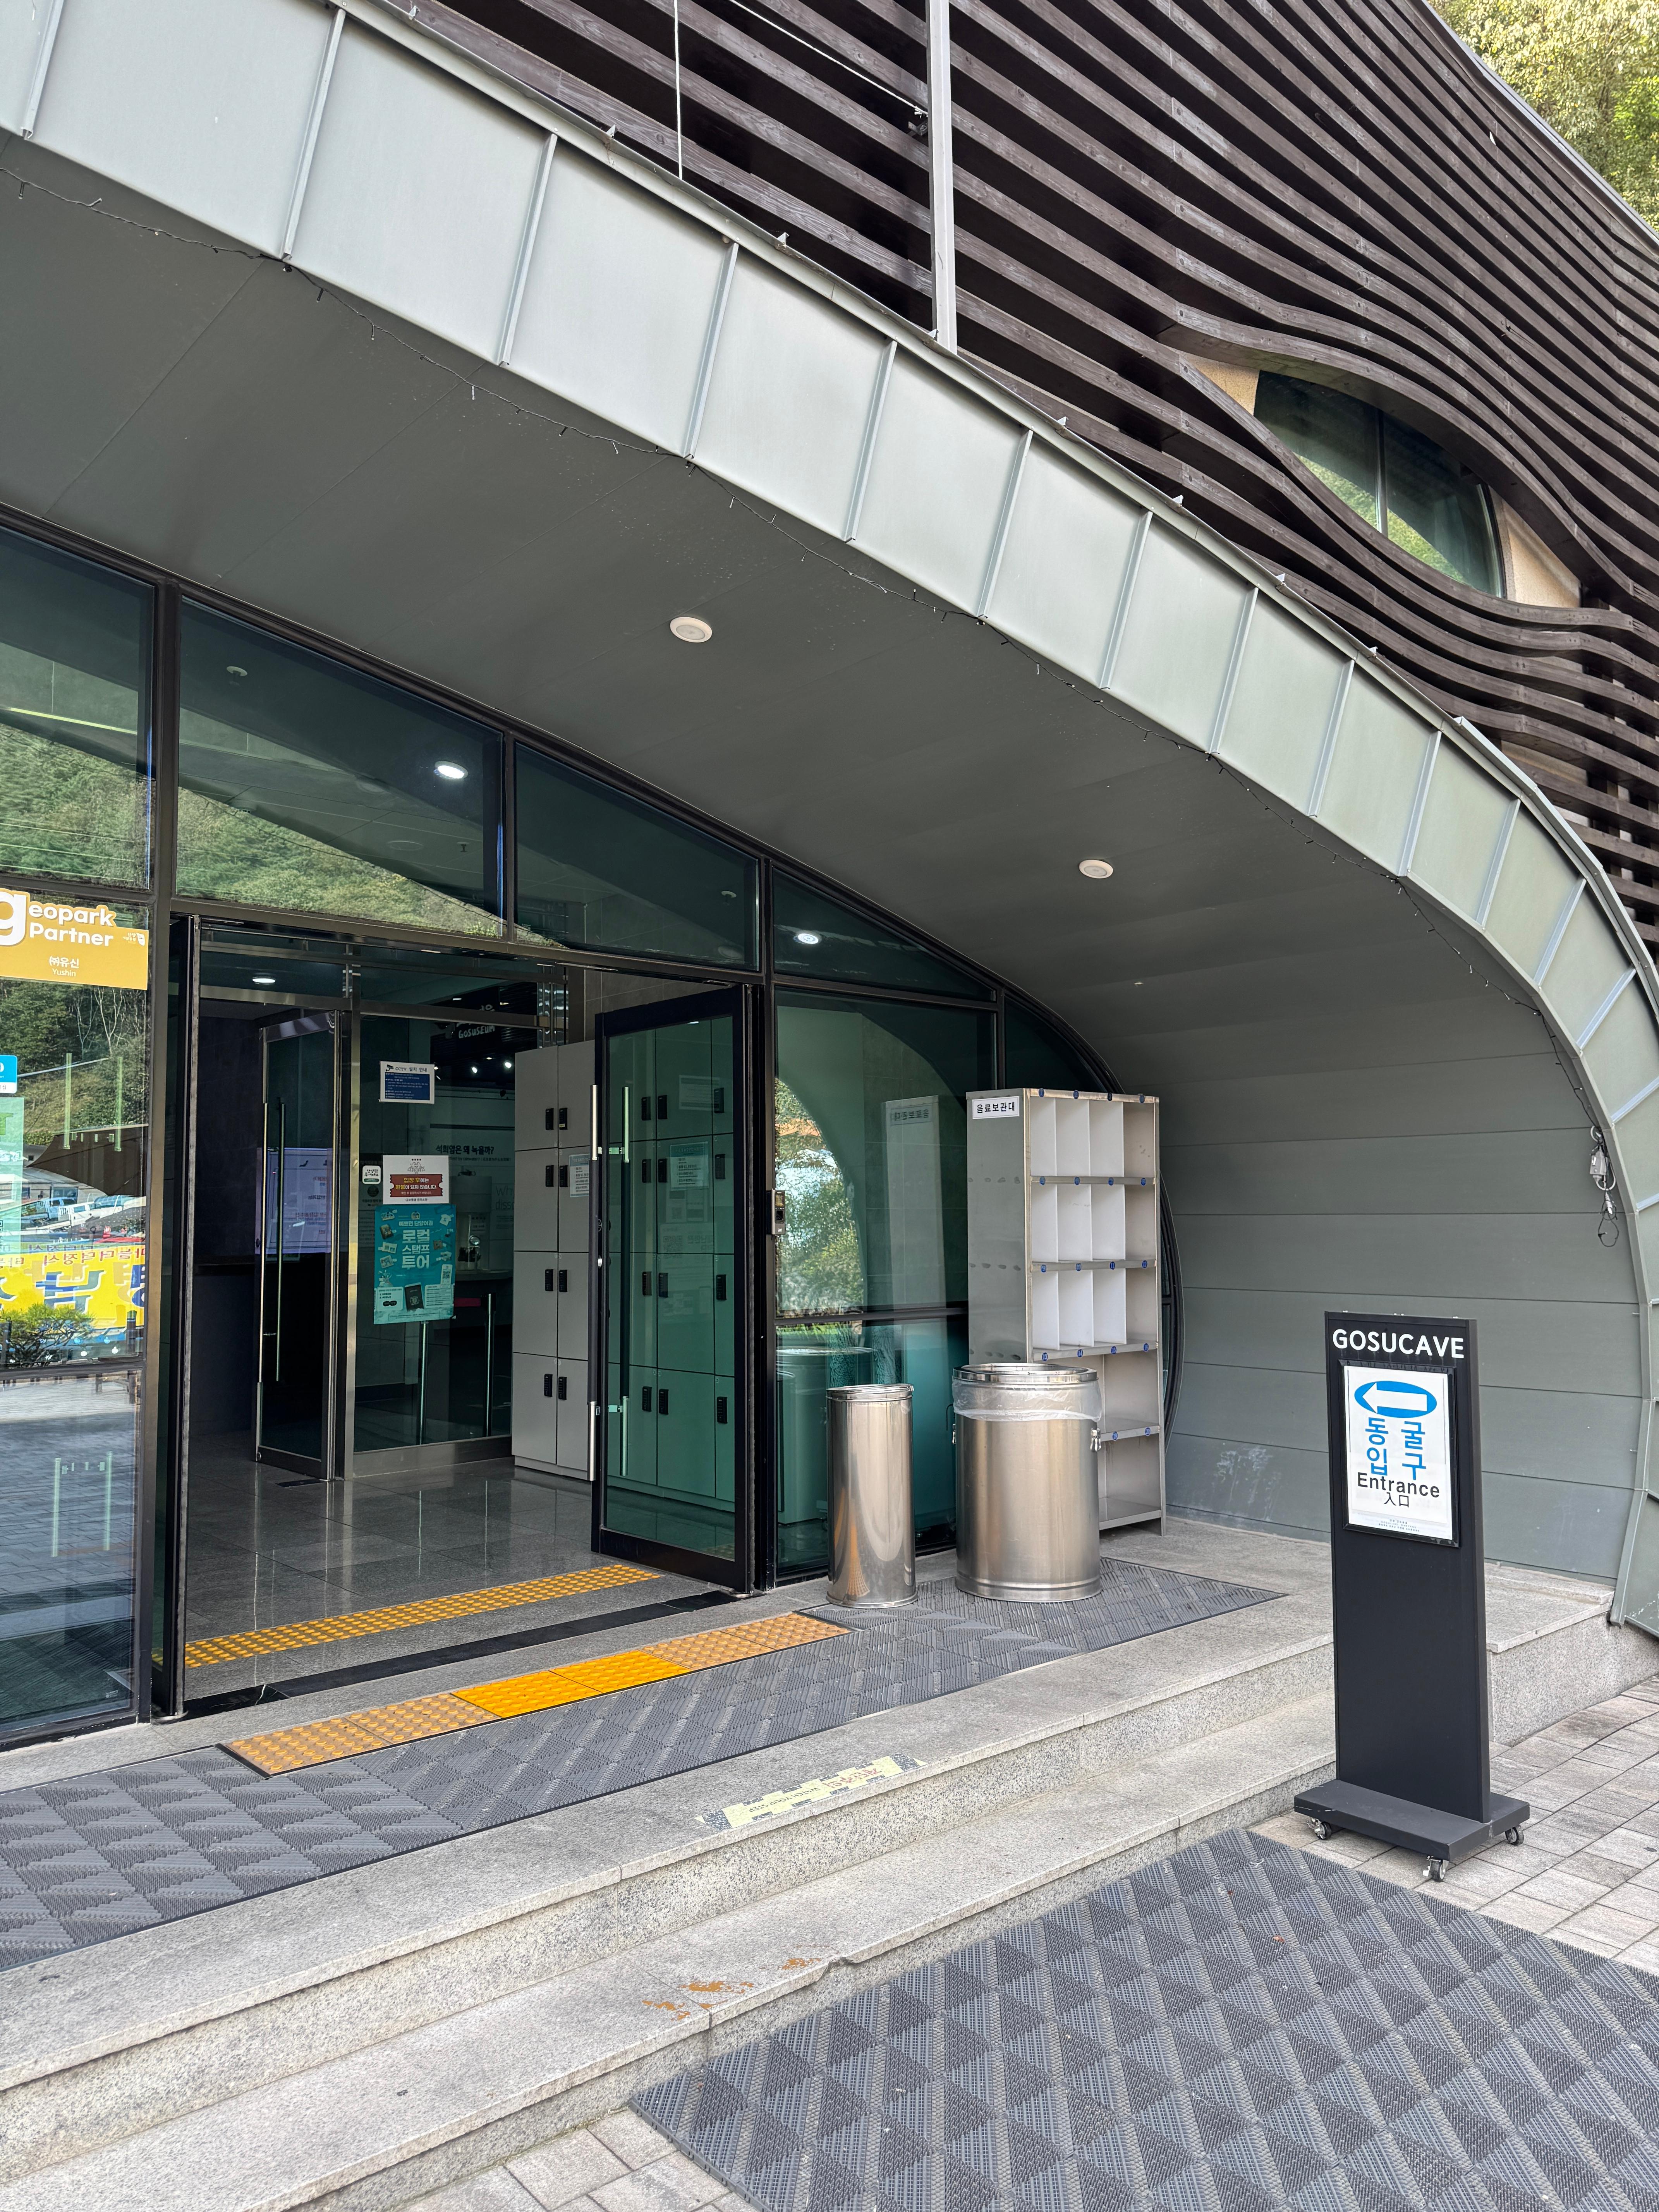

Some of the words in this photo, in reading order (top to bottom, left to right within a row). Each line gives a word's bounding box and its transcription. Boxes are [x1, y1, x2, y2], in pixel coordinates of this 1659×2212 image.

[29, 922, 114, 946] Partner
[52, 968, 76, 977] Yushin
[977, 1101, 1015, 1114] 음료보관대
[402, 1229, 430, 1243] 로컬
[402, 1244, 430, 1254] 스탬프
[402, 1254, 429, 1270] 투어
[1333, 1329, 1464, 1358] GOSUCAVE
[1358, 1472, 1440, 1498] Entrance
[1384, 1492, 1409, 1508] 入口
[792, 1787, 821, 1798] WATCH
[749, 1804, 769, 1812] STEP
